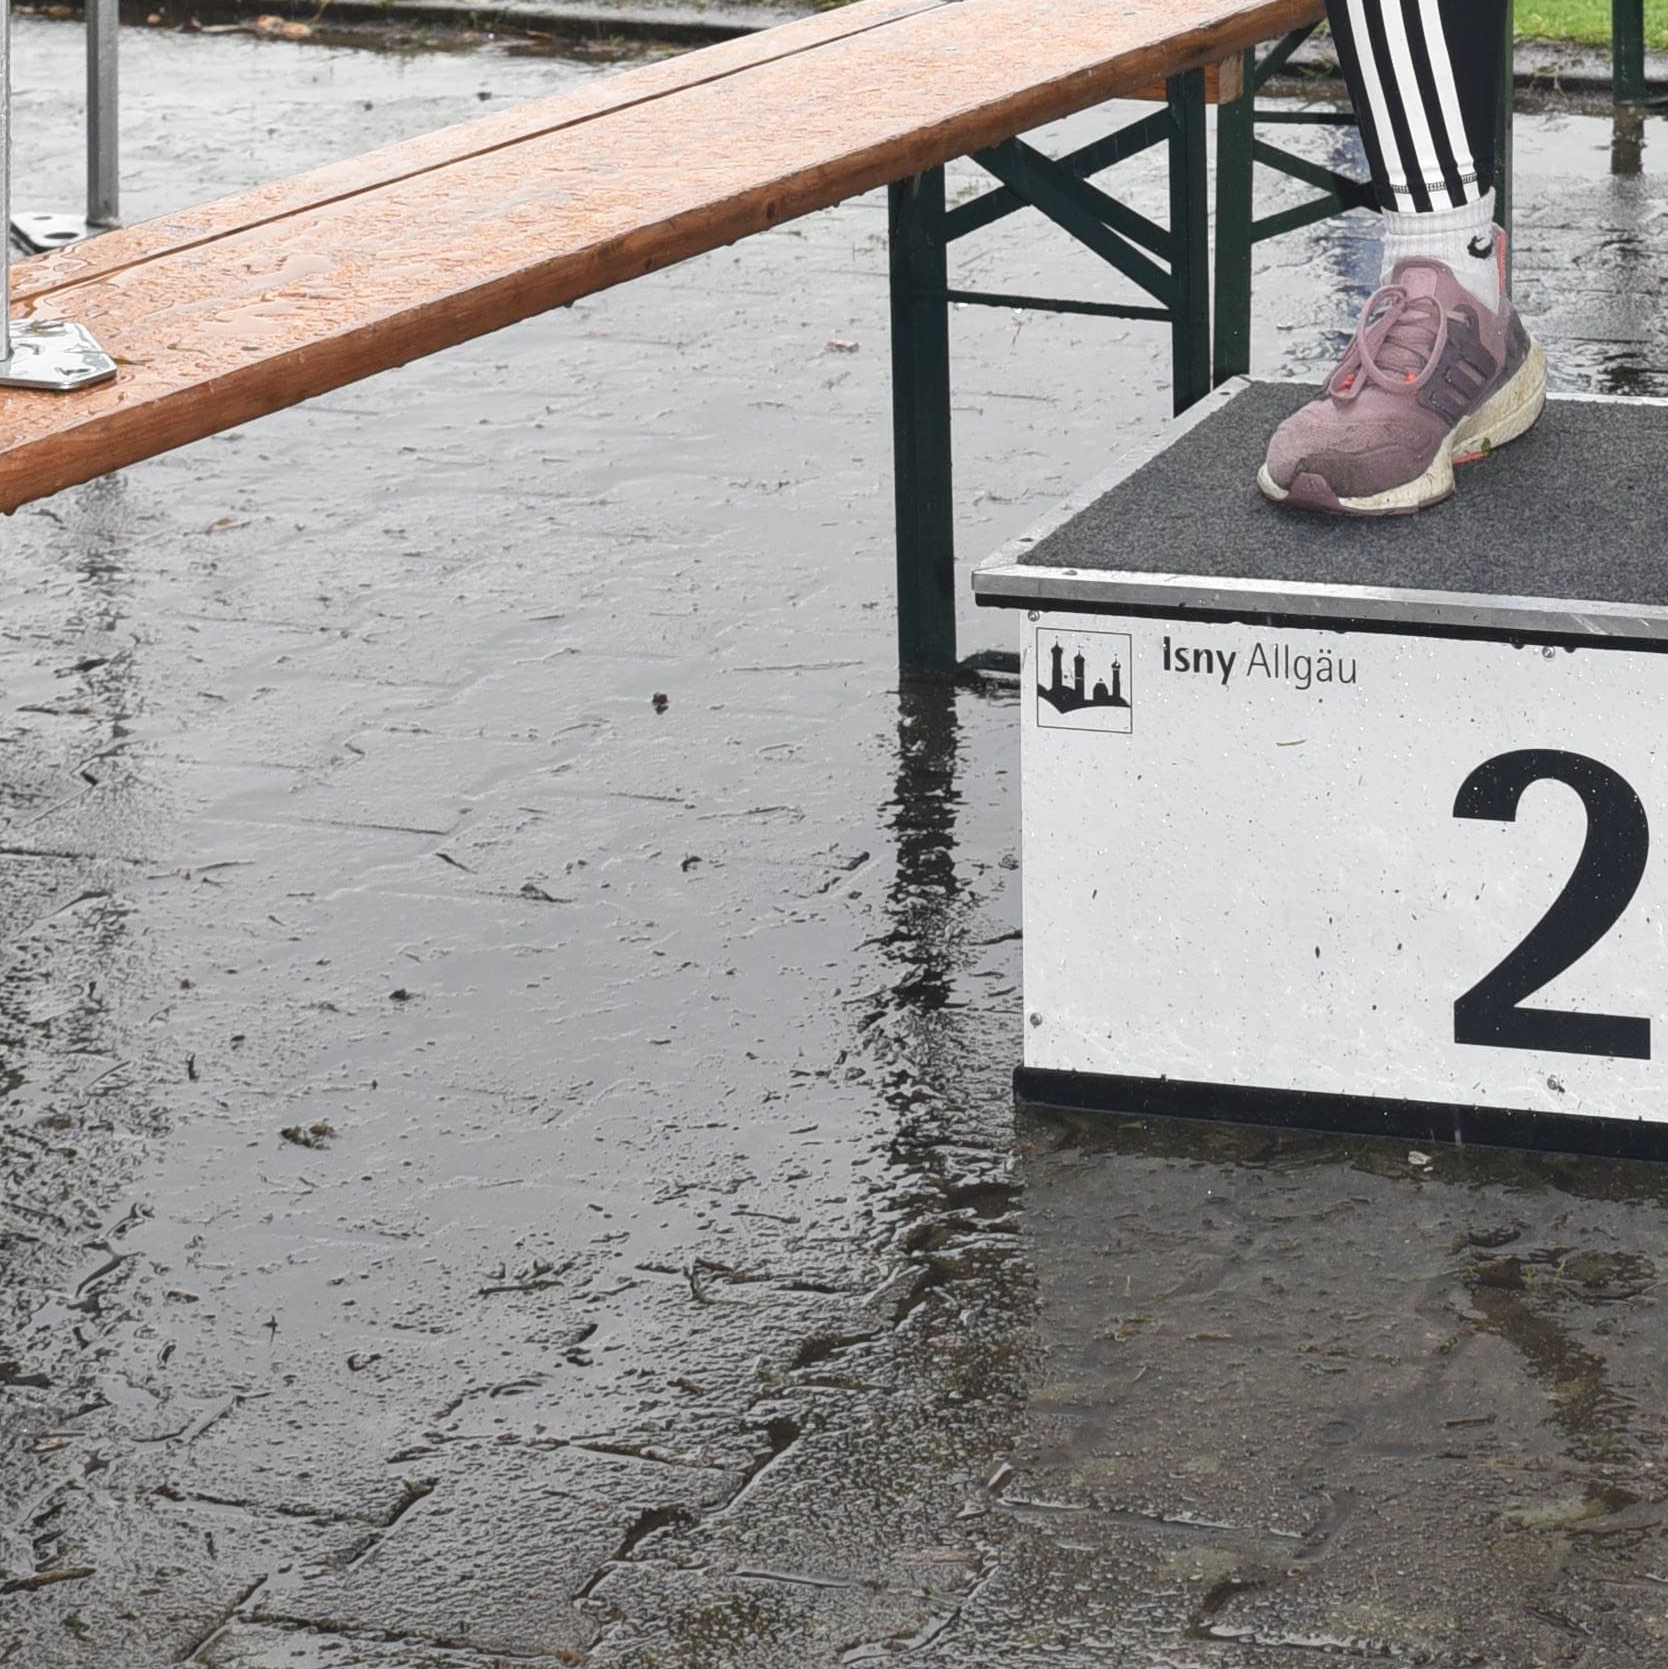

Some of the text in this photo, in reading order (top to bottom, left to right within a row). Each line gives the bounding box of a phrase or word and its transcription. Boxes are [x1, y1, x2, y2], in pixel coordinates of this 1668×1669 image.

[1163, 636, 1358, 690] Isny Allgäu
[1453, 748, 1651, 1060] 2
